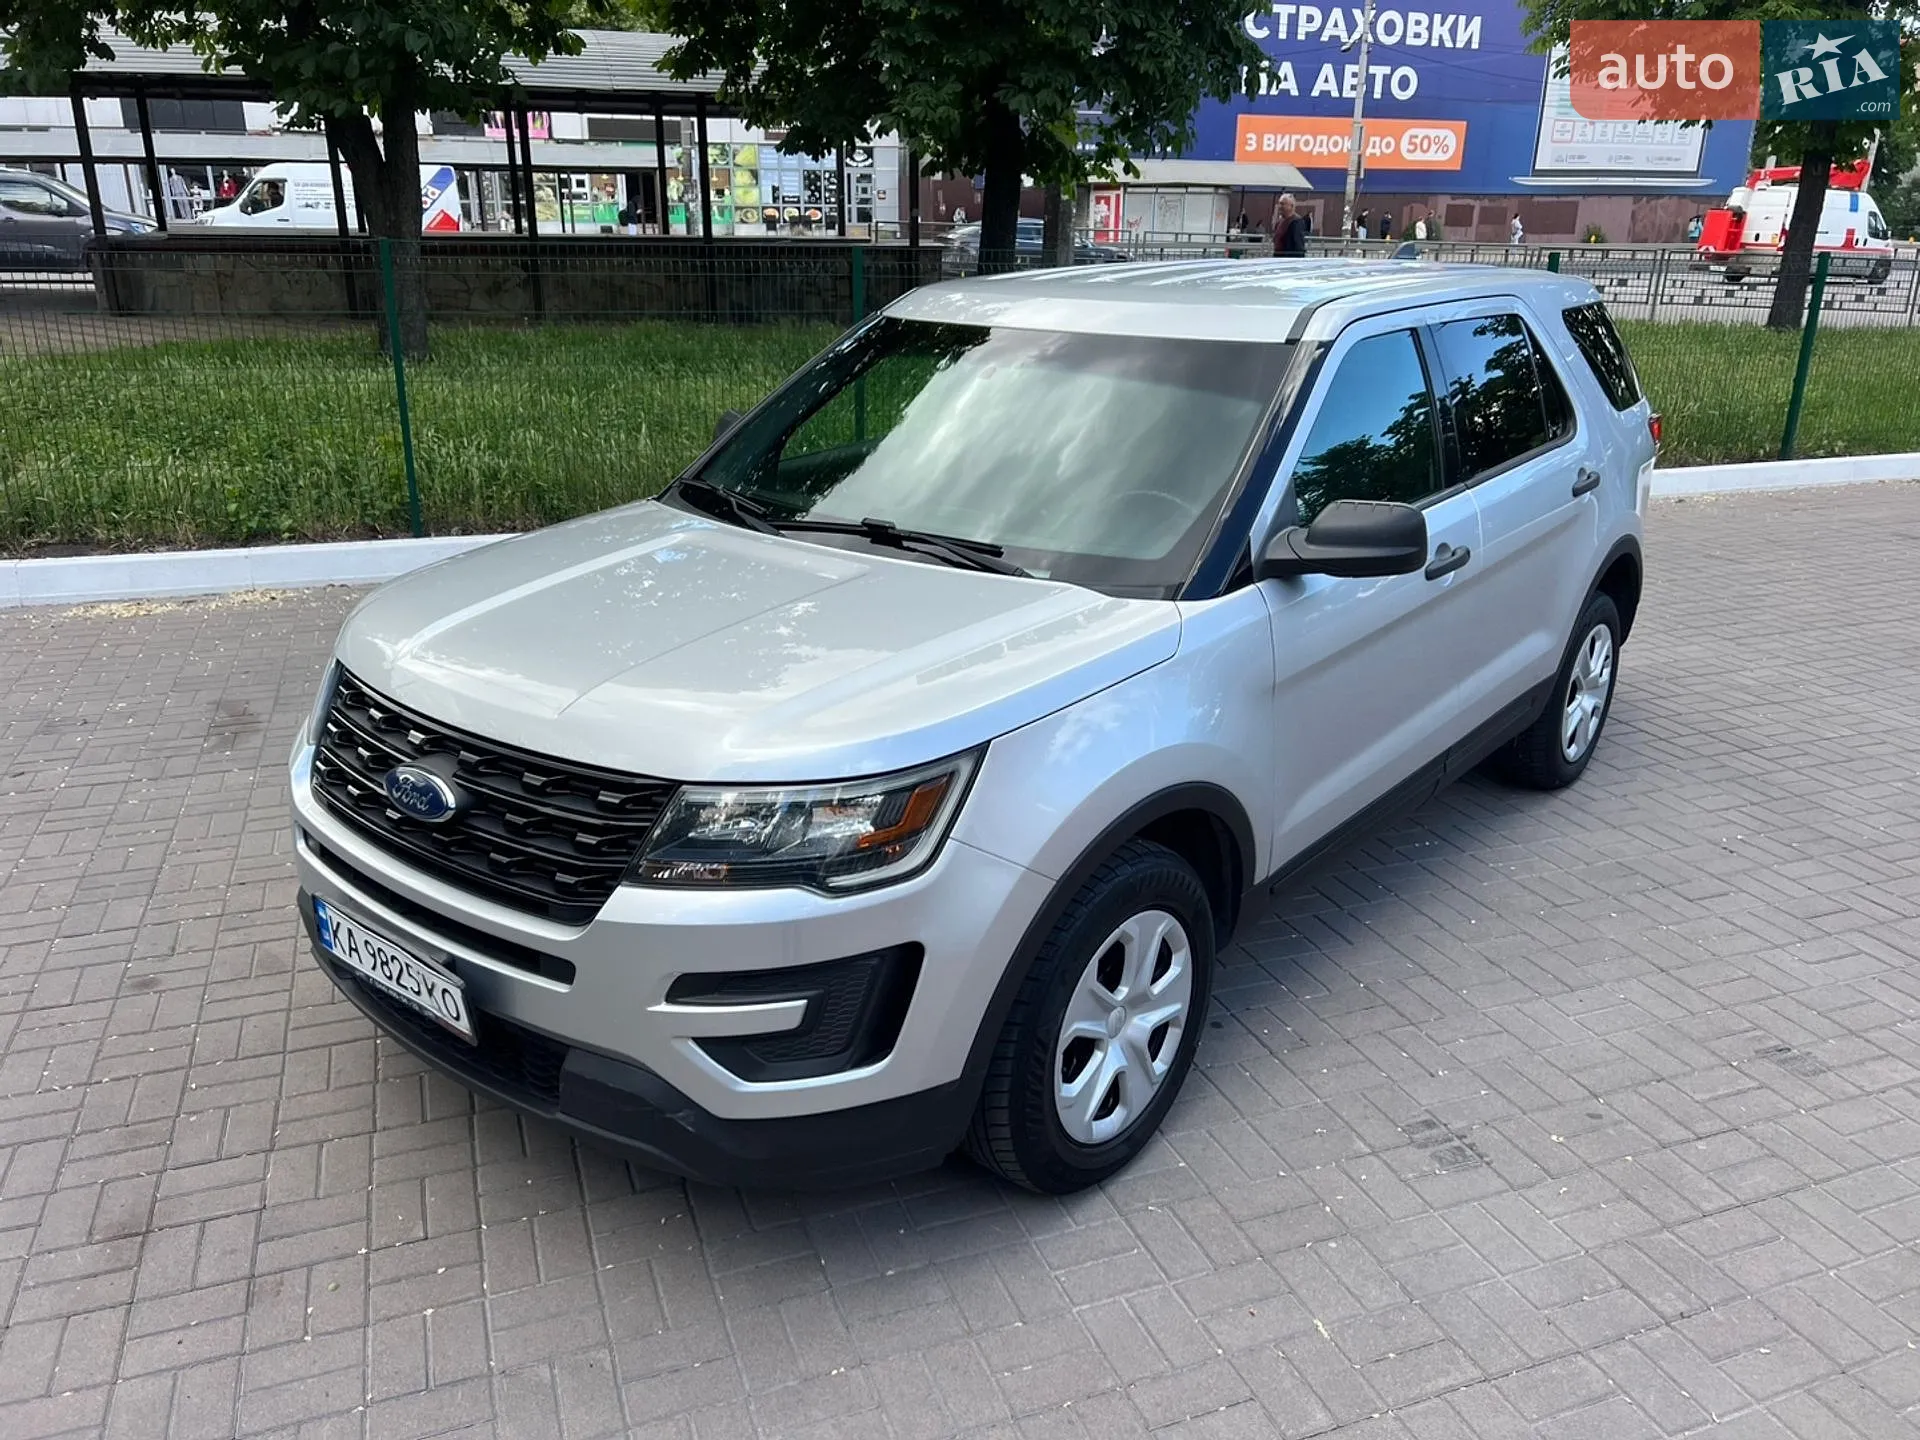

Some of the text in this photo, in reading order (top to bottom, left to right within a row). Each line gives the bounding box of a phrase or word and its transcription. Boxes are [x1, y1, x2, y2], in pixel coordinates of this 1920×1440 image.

[1244, 4, 1482, 49] СТРАХОВКИ
[1311, 63, 1418, 100] АВТО
[1407, 134, 1450, 155] 50%
[392, 774, 433, 811] Ford
